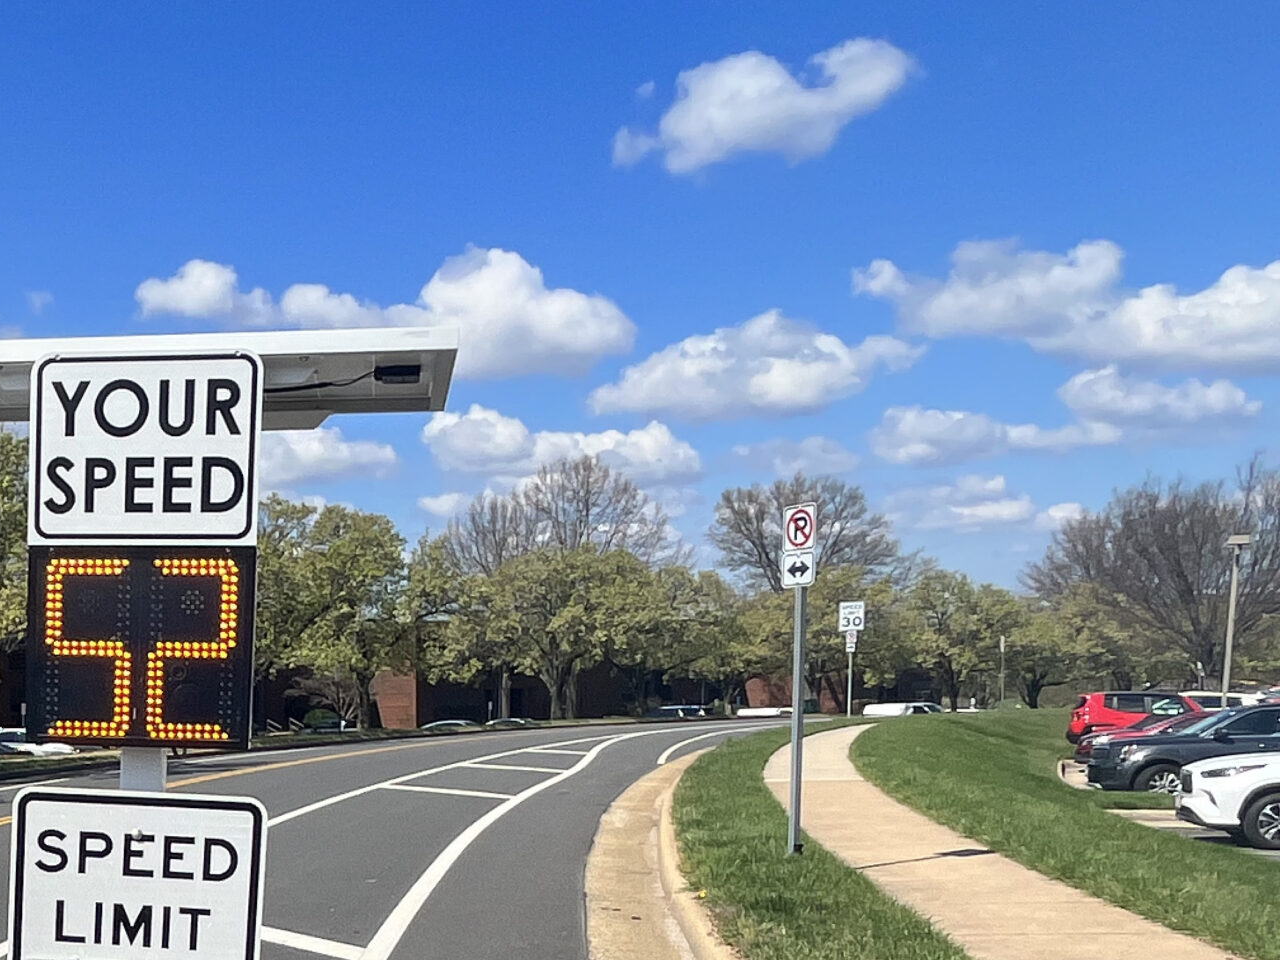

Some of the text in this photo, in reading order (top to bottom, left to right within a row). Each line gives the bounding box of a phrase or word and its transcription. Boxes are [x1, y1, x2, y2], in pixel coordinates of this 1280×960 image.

[52, 378, 242, 437] YOUR
[43, 456, 245, 515] SPEED
[45, 558, 240, 740] 52
[841, 616, 862, 628] 30
[35, 829, 239, 882] SPEED
[54, 900, 212, 951] LIMIT
